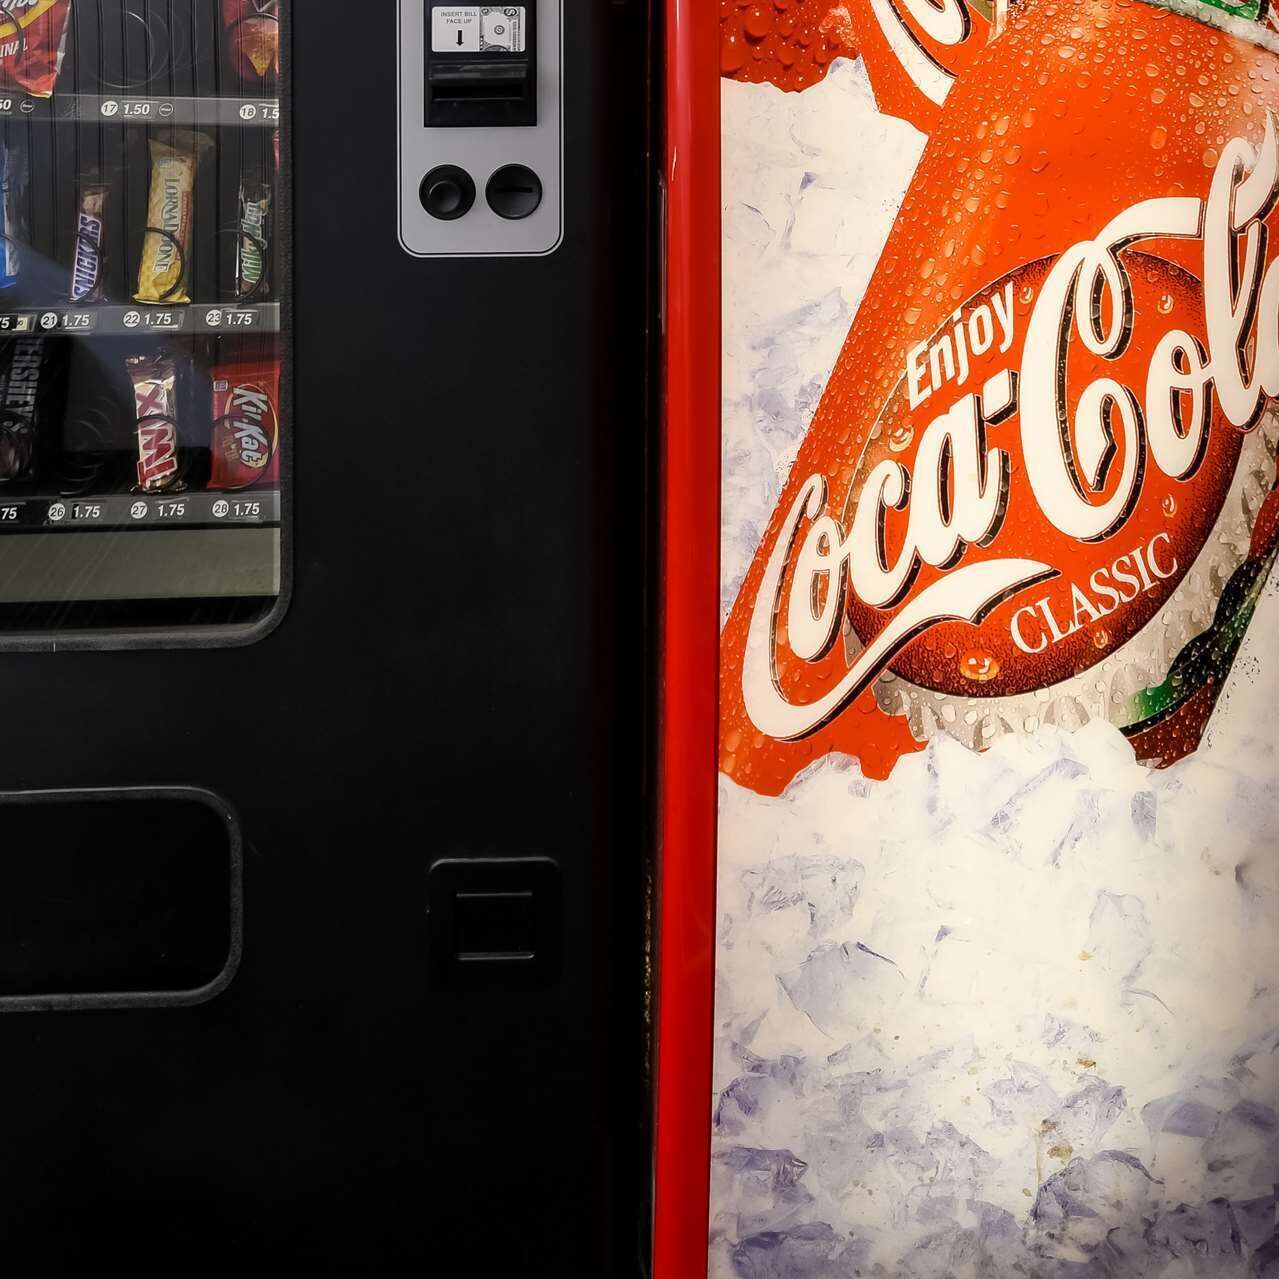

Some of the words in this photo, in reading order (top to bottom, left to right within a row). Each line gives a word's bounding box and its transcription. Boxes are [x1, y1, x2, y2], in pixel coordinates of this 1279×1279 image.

[103, 104, 116, 114] 17
[123, 103, 150, 115] 1.50
[241, 107, 254, 116] 18
[261, 107, 279, 119] 1.5
[41, 314, 57, 326] 21
[62, 315, 90, 326] 1.75
[124, 313, 139, 324] 22
[144, 313, 172, 325] 1.75
[207, 313, 221, 323] 23
[226, 313, 252, 325] 1.75
[906, 282, 1015, 410] Enjoy
[136, 384, 178, 484] TWIX
[49, 506, 64, 517] 26
[73, 506, 100, 518] 1.75
[132, 505, 146, 515] 27
[158, 504, 185, 516] 1.75
[214, 503, 228, 514] 28
[234, 503, 260, 516] 1.75
[1010, 532, 1179, 655] CLASSIC
